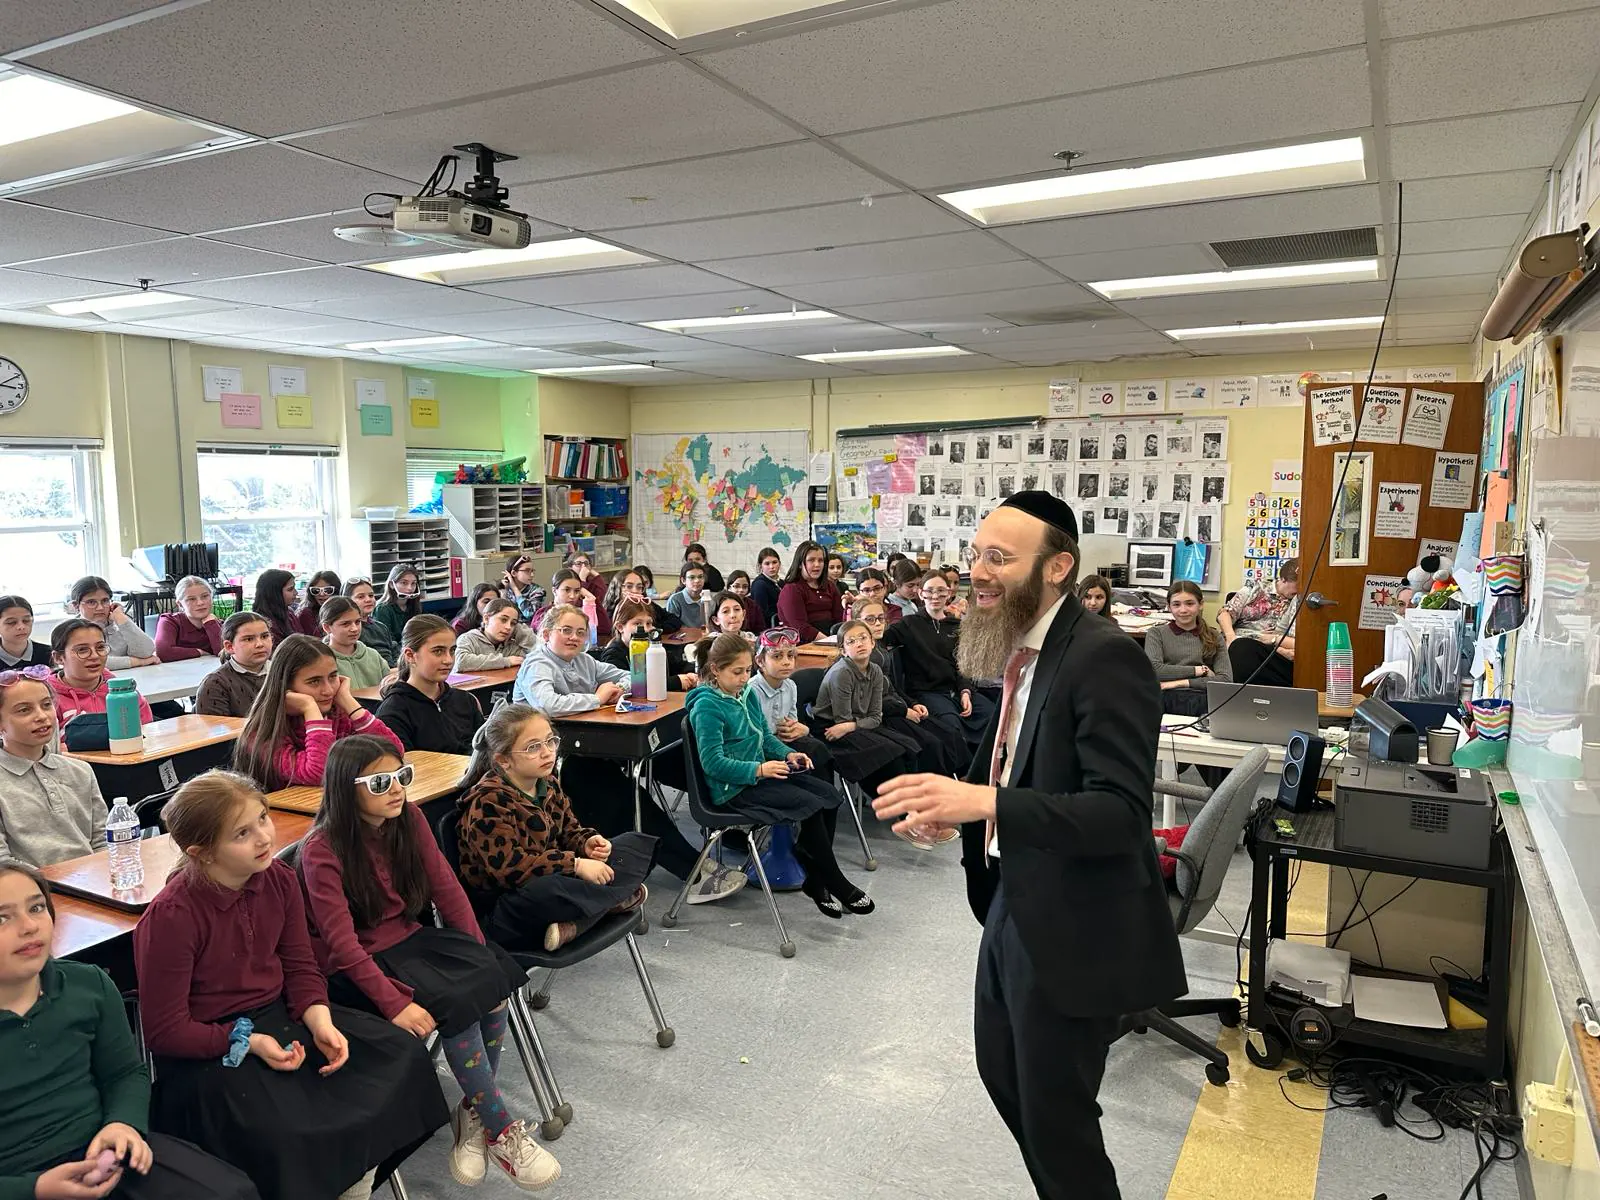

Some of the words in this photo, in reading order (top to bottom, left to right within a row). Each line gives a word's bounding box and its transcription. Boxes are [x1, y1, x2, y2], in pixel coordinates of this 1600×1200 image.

[1324, 389, 1352, 398] Scientific
[1370, 388, 1399, 397] Question
[1321, 396, 1344, 404] Method
[1375, 396, 1401, 405] Purpose
[1416, 394, 1447, 405] Research
[1438, 456, 1474, 465] Hypothesis
[1380, 487, 1419, 495] Experiment
[1426, 544, 1453, 553] Analysis
[1366, 580, 1402, 588] Conclusio
